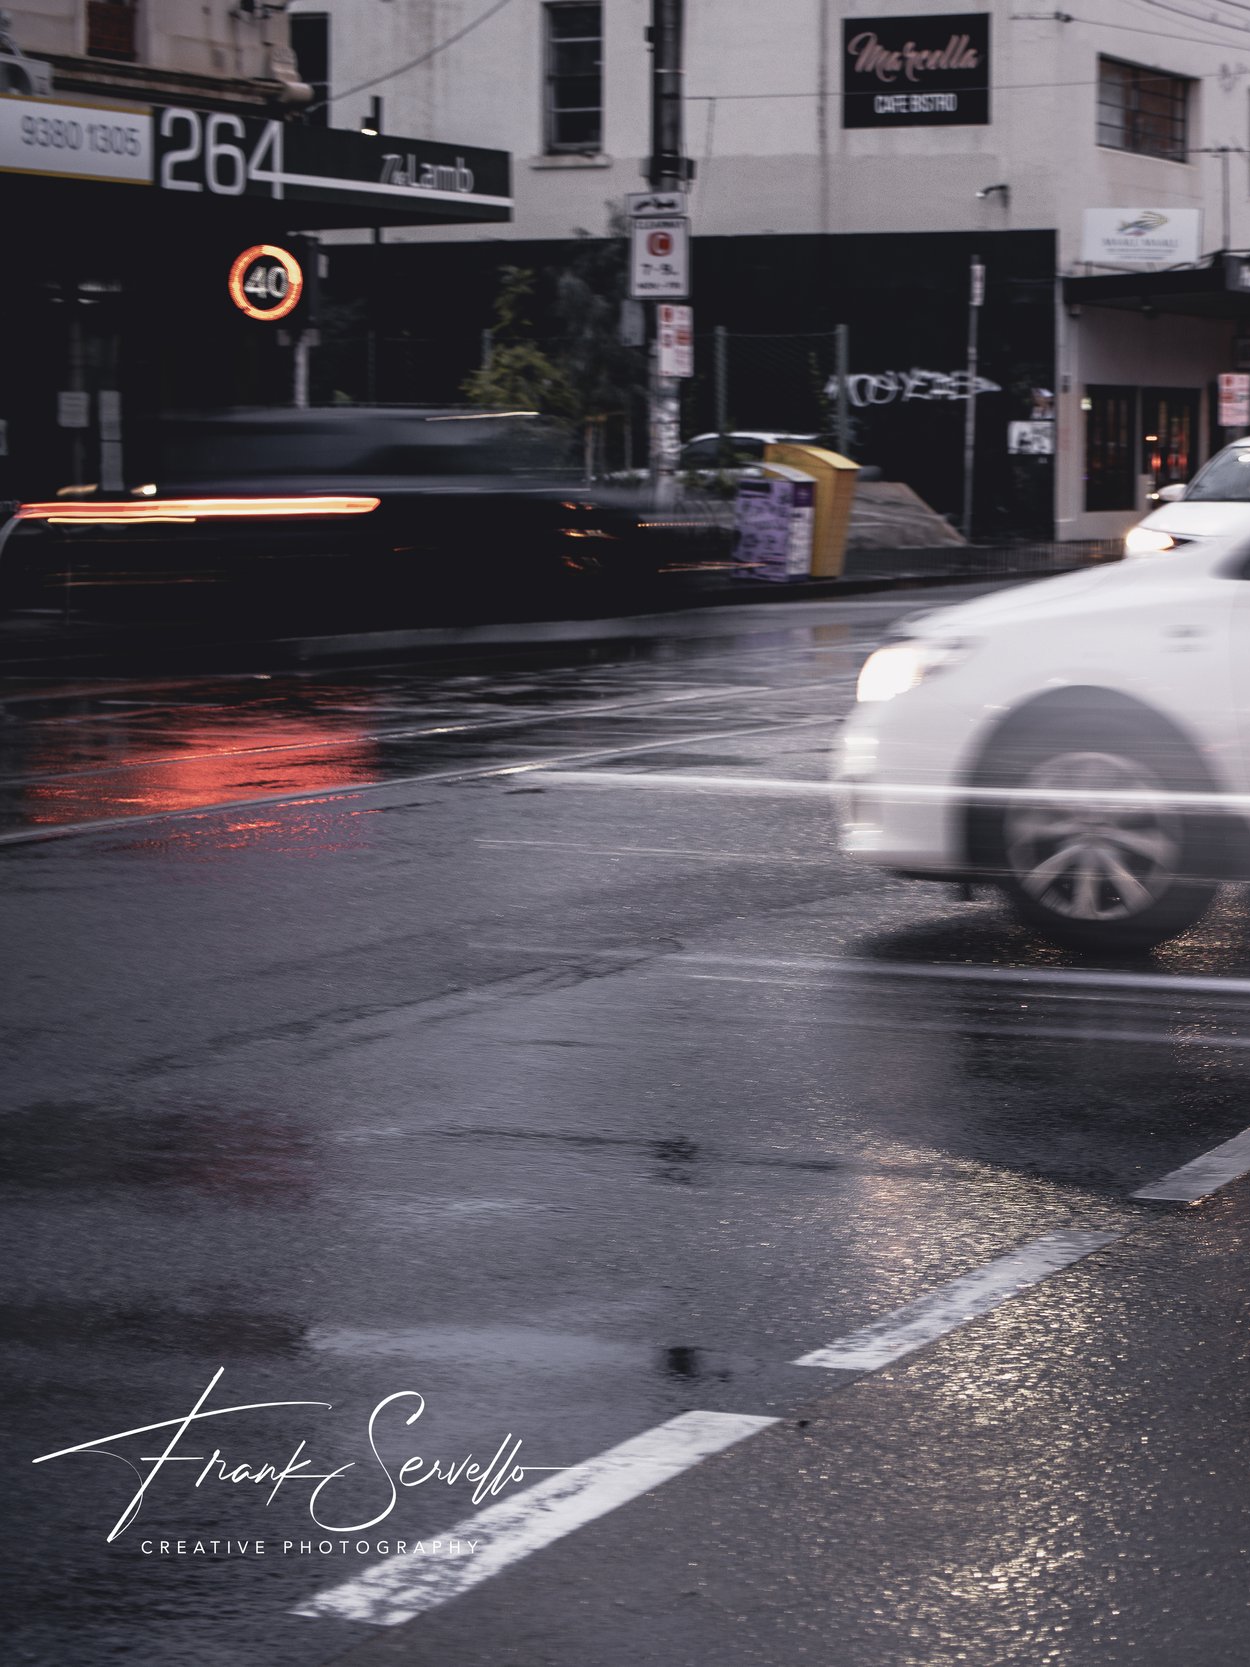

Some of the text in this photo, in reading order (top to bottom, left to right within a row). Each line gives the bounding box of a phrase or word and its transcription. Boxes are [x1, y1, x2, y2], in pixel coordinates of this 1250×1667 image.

[847, 32, 981, 82] Marcella
[874, 93, 957, 114] CAFE BISTRO
[20, 114, 142, 157] 9380 1305
[160, 107, 284, 200] 264
[244, 266, 289, 299] 40
